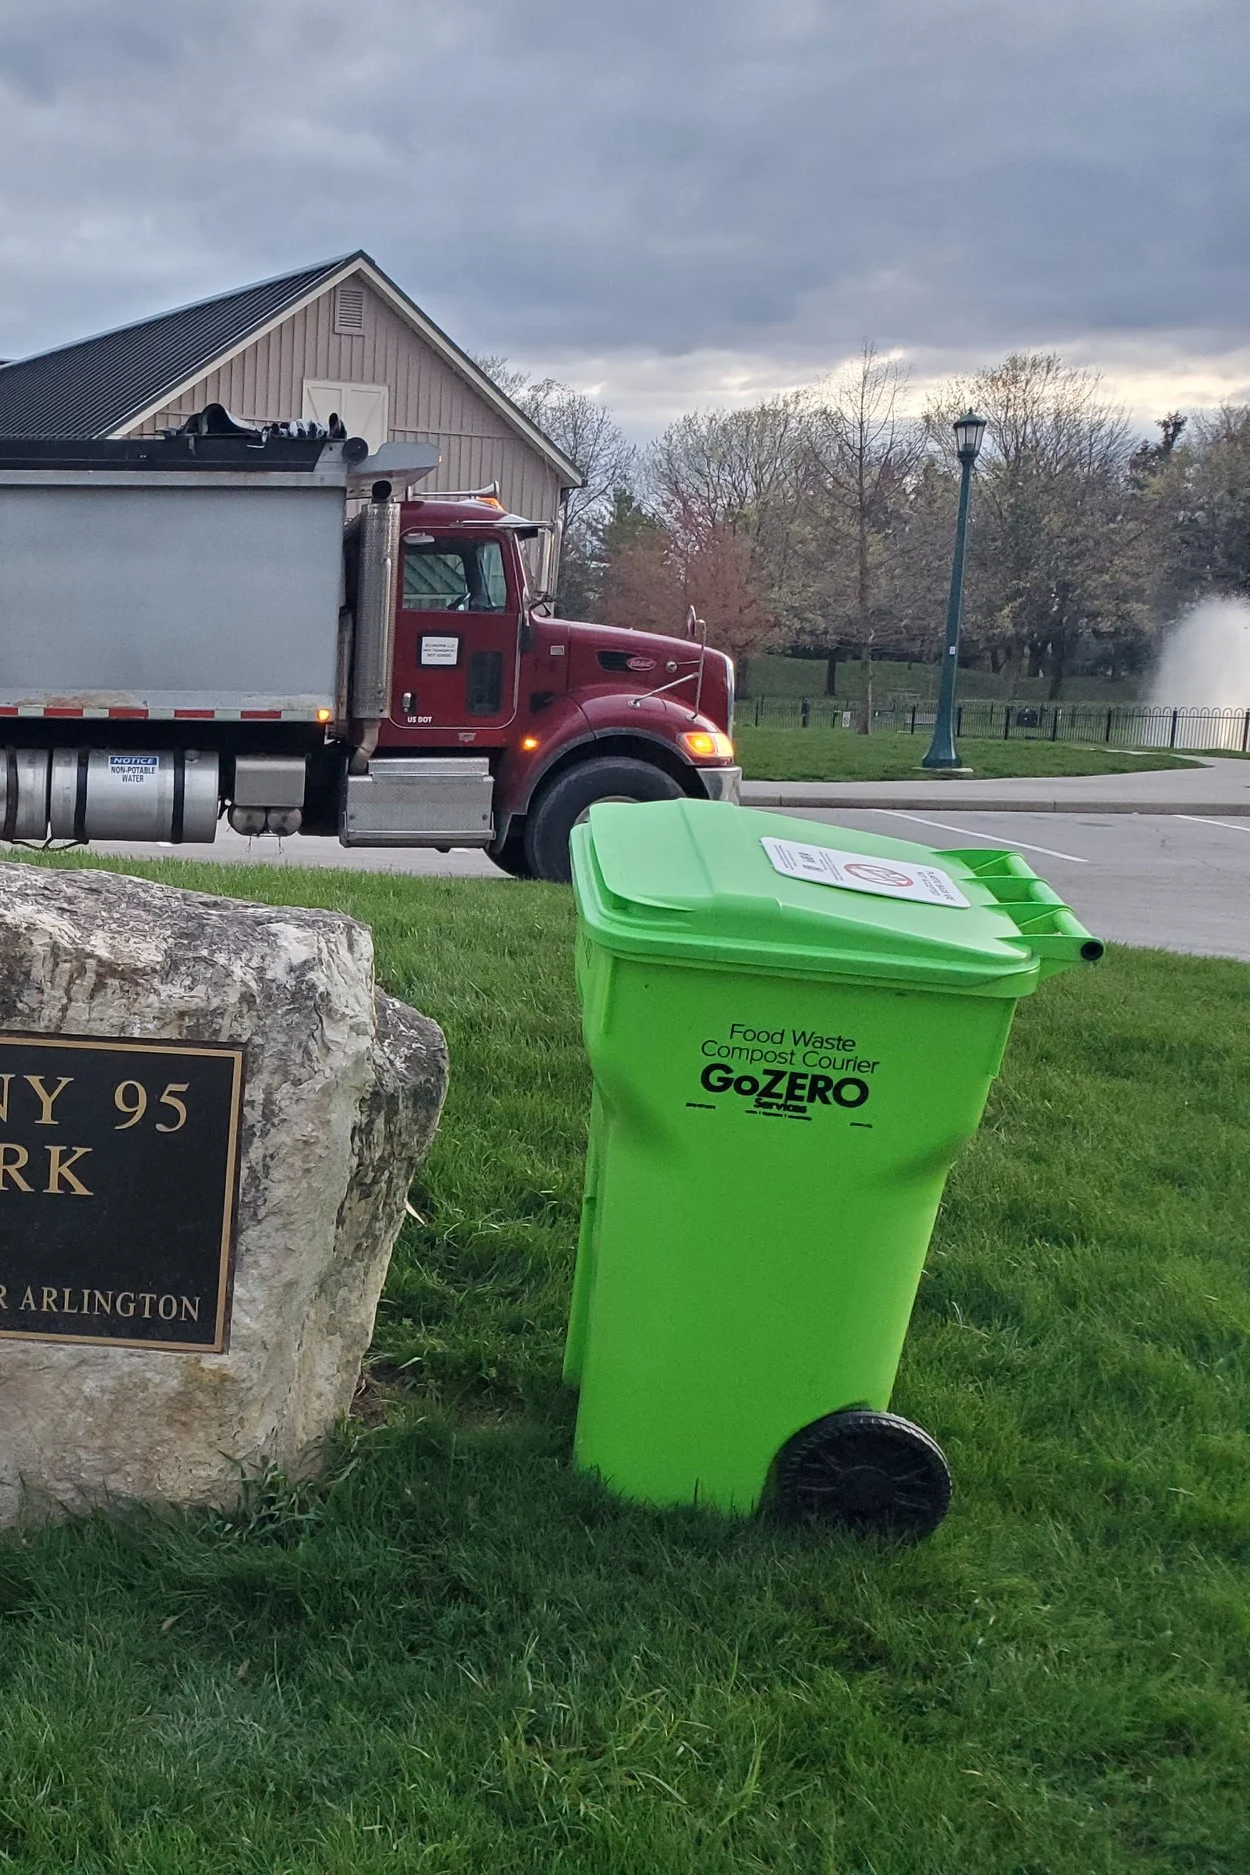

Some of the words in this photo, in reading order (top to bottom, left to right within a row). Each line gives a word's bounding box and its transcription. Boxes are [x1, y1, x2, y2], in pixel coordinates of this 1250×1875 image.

[111, 766, 156, 775] NON-POTABLE
[113, 756, 153, 765] NOTICE
[121, 774, 144, 783] WATER
[729, 1023, 785, 1045] Food
[792, 1029, 856, 1052] Waste
[701, 1039, 796, 1066] Compost
[802, 1050, 880, 1075] Courier
[700, 1063, 869, 1108] GoZERO
[114, 1079, 191, 1133] 95
[19, 1285, 201, 1323] ARLINGTON
